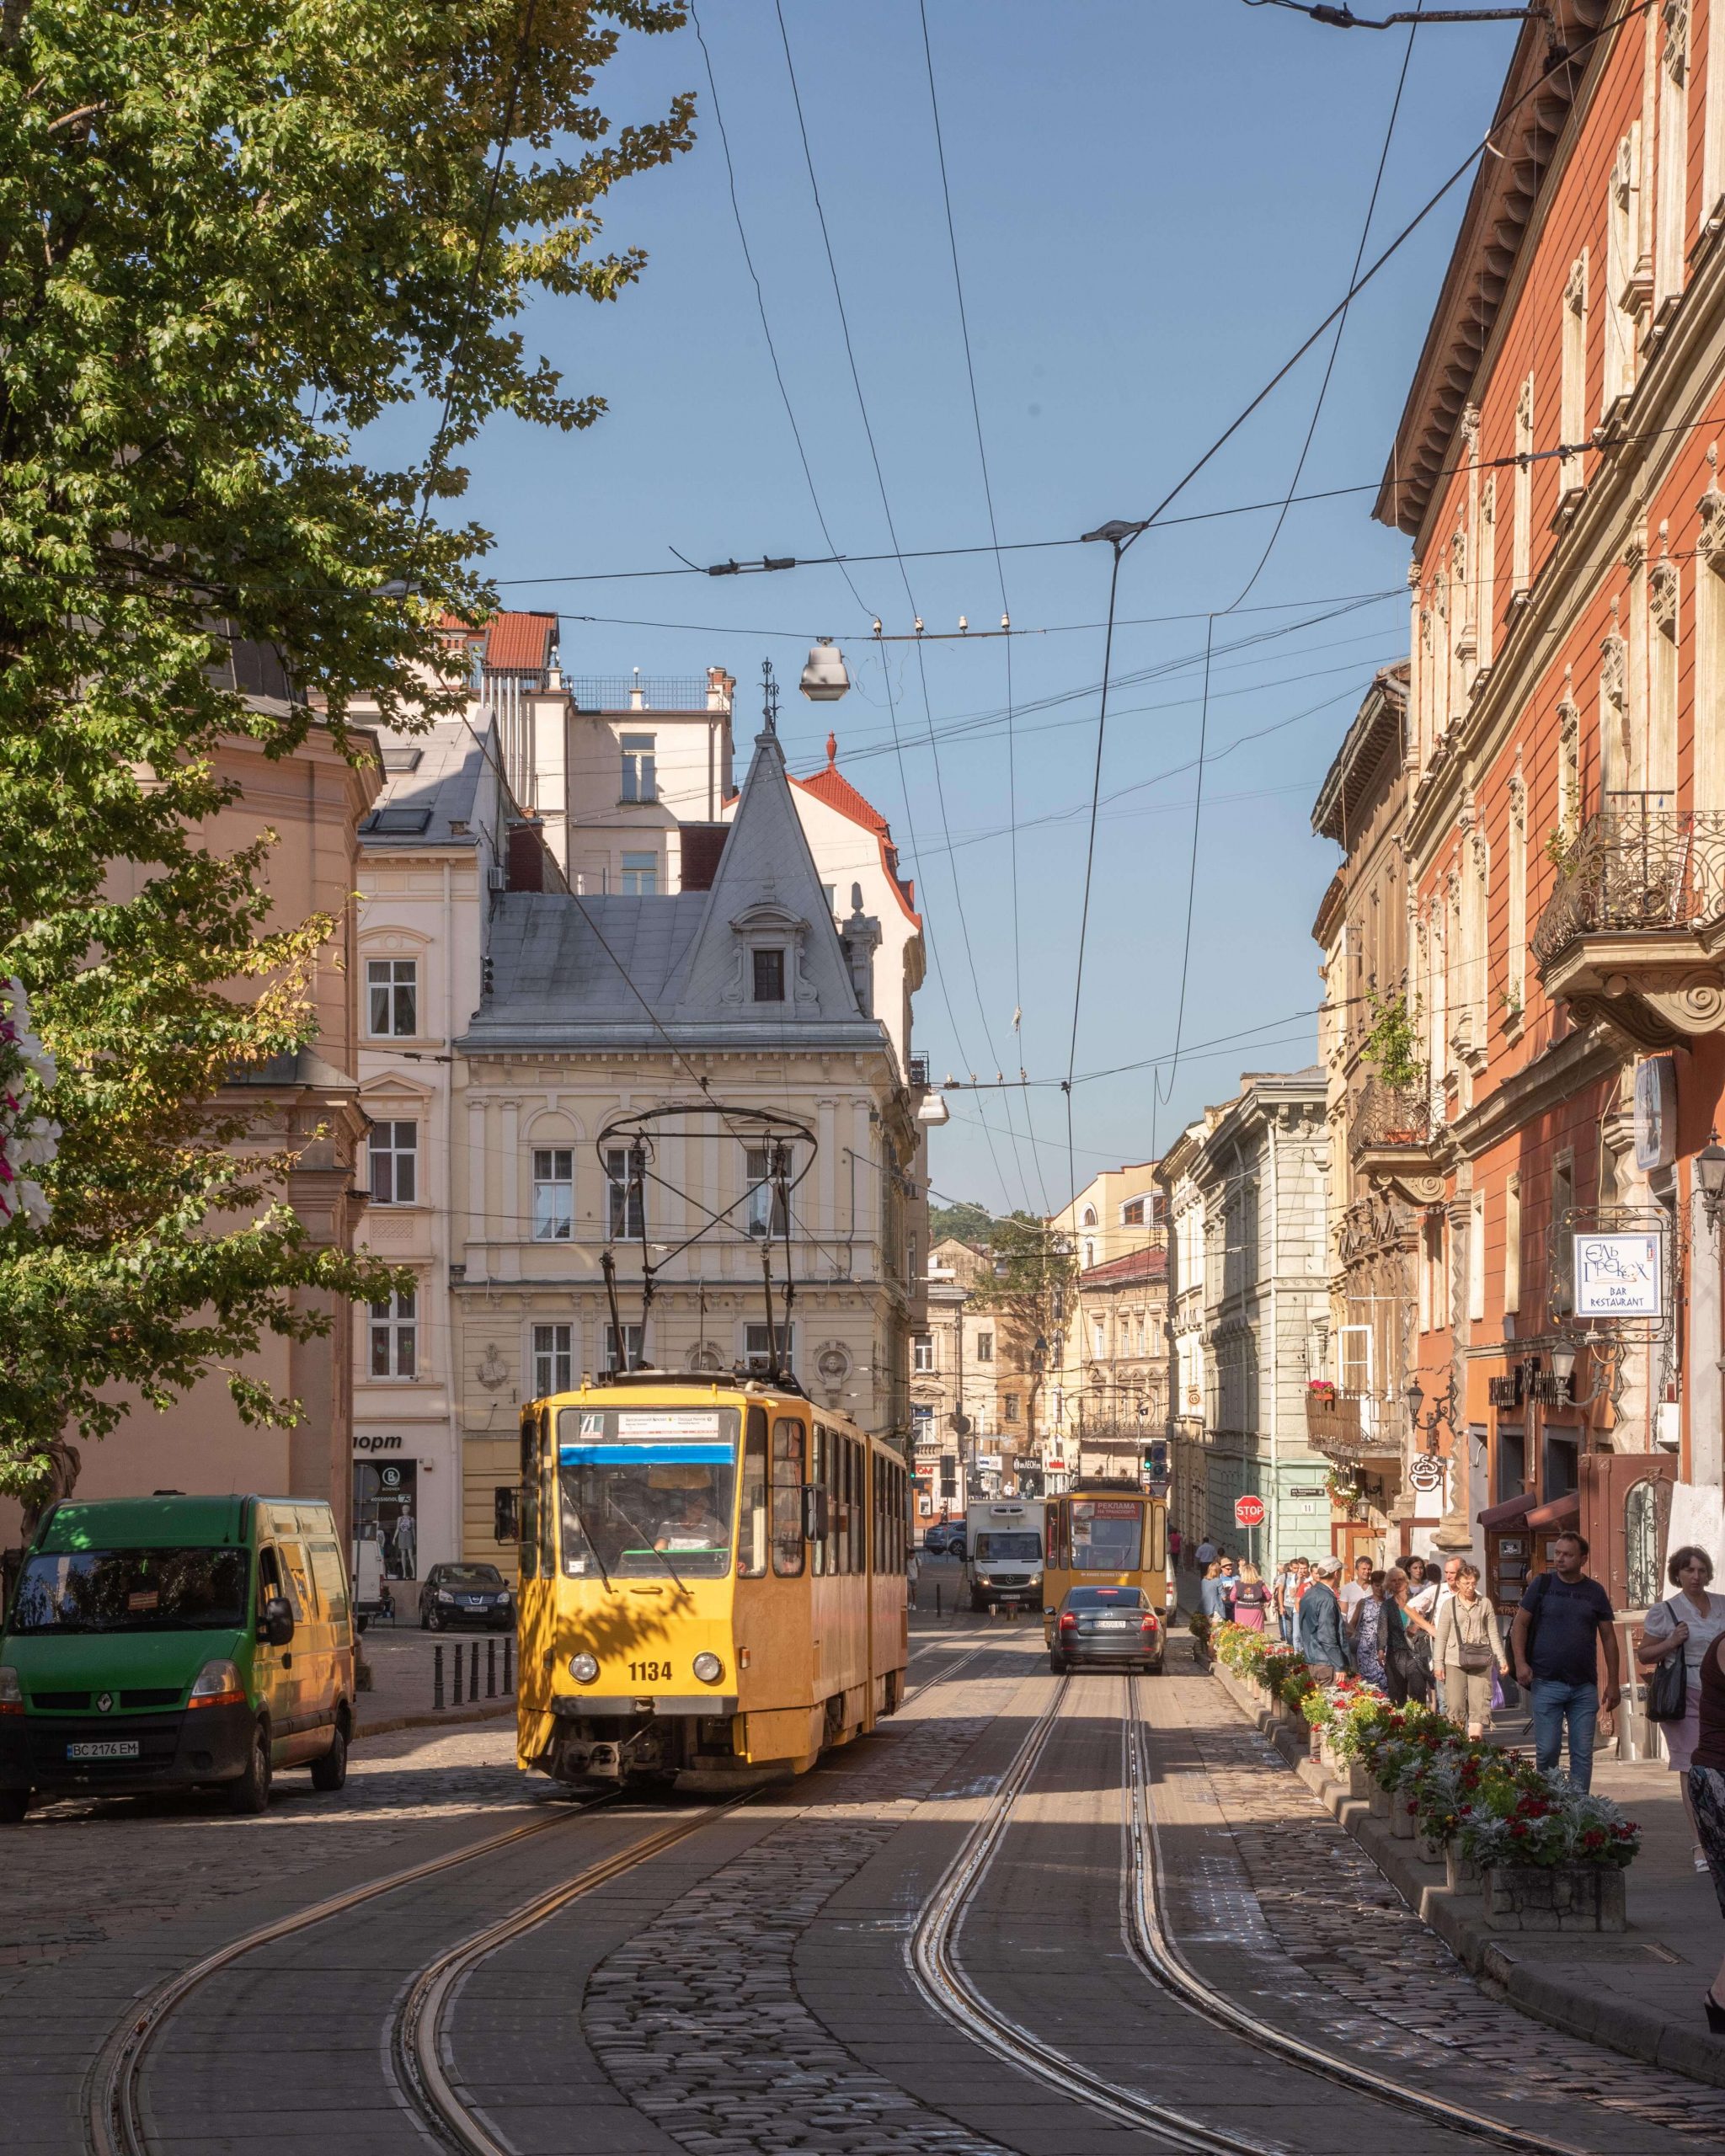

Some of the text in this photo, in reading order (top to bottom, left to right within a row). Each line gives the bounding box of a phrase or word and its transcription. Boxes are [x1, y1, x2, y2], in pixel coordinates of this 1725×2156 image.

[1610, 1287, 1626, 1296] BAR
[1590, 1298, 1644, 1307] RESTAURANT
[1236, 1506, 1263, 1516] STOP
[1304, 1504, 1311, 1513] 11
[628, 1661, 673, 1682] 1134
[73, 1743, 136, 1757] BC 2176 EM
